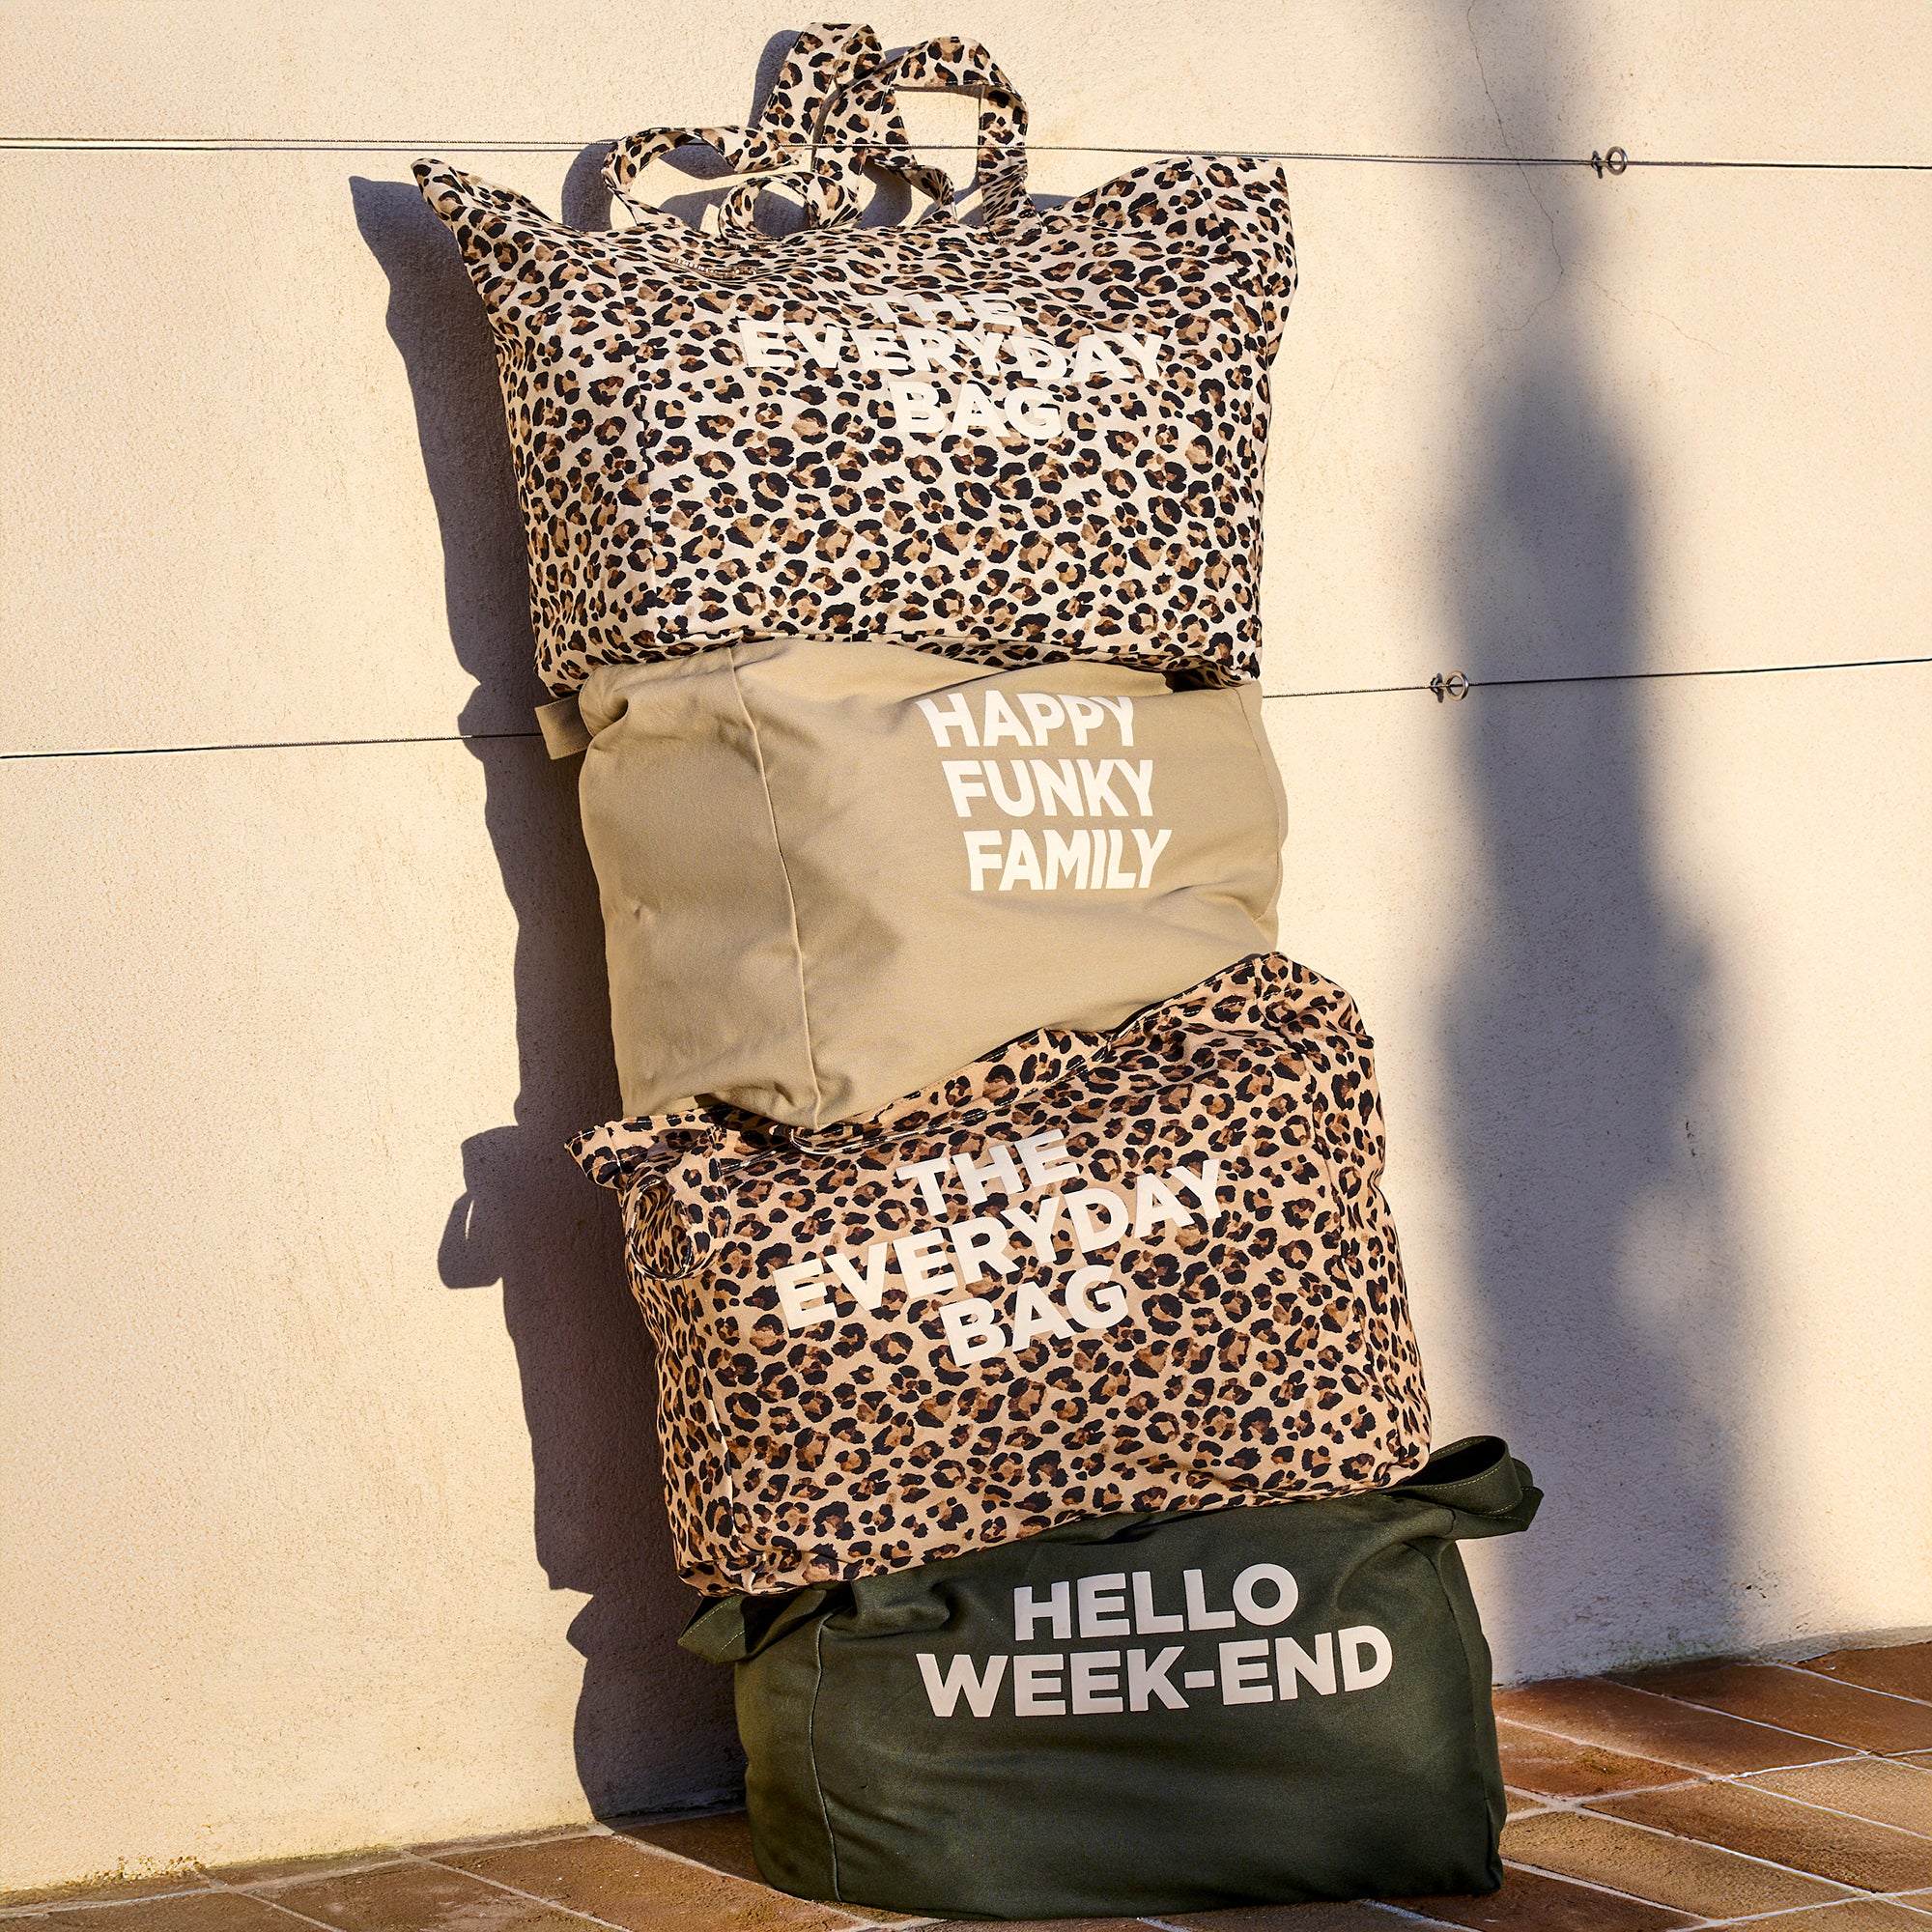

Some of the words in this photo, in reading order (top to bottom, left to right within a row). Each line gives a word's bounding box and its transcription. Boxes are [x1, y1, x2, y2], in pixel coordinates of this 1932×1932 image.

[852, 293, 1022, 327] THE
[739, 320, 1165, 383] EVERYDAY
[891, 382, 1063, 439] BAG
[916, 690, 1135, 748] HAPPY
[941, 759, 1154, 817] FUNKY
[963, 829, 1173, 892] FAMILY
[895, 1128, 1080, 1217] THE
[772, 1158, 1226, 1331] EVERYDAY
[939, 1264, 1129, 1368] BAG
[1013, 1563, 1299, 1641] HELLO
[915, 1625, 1393, 1718] WEEK-END
